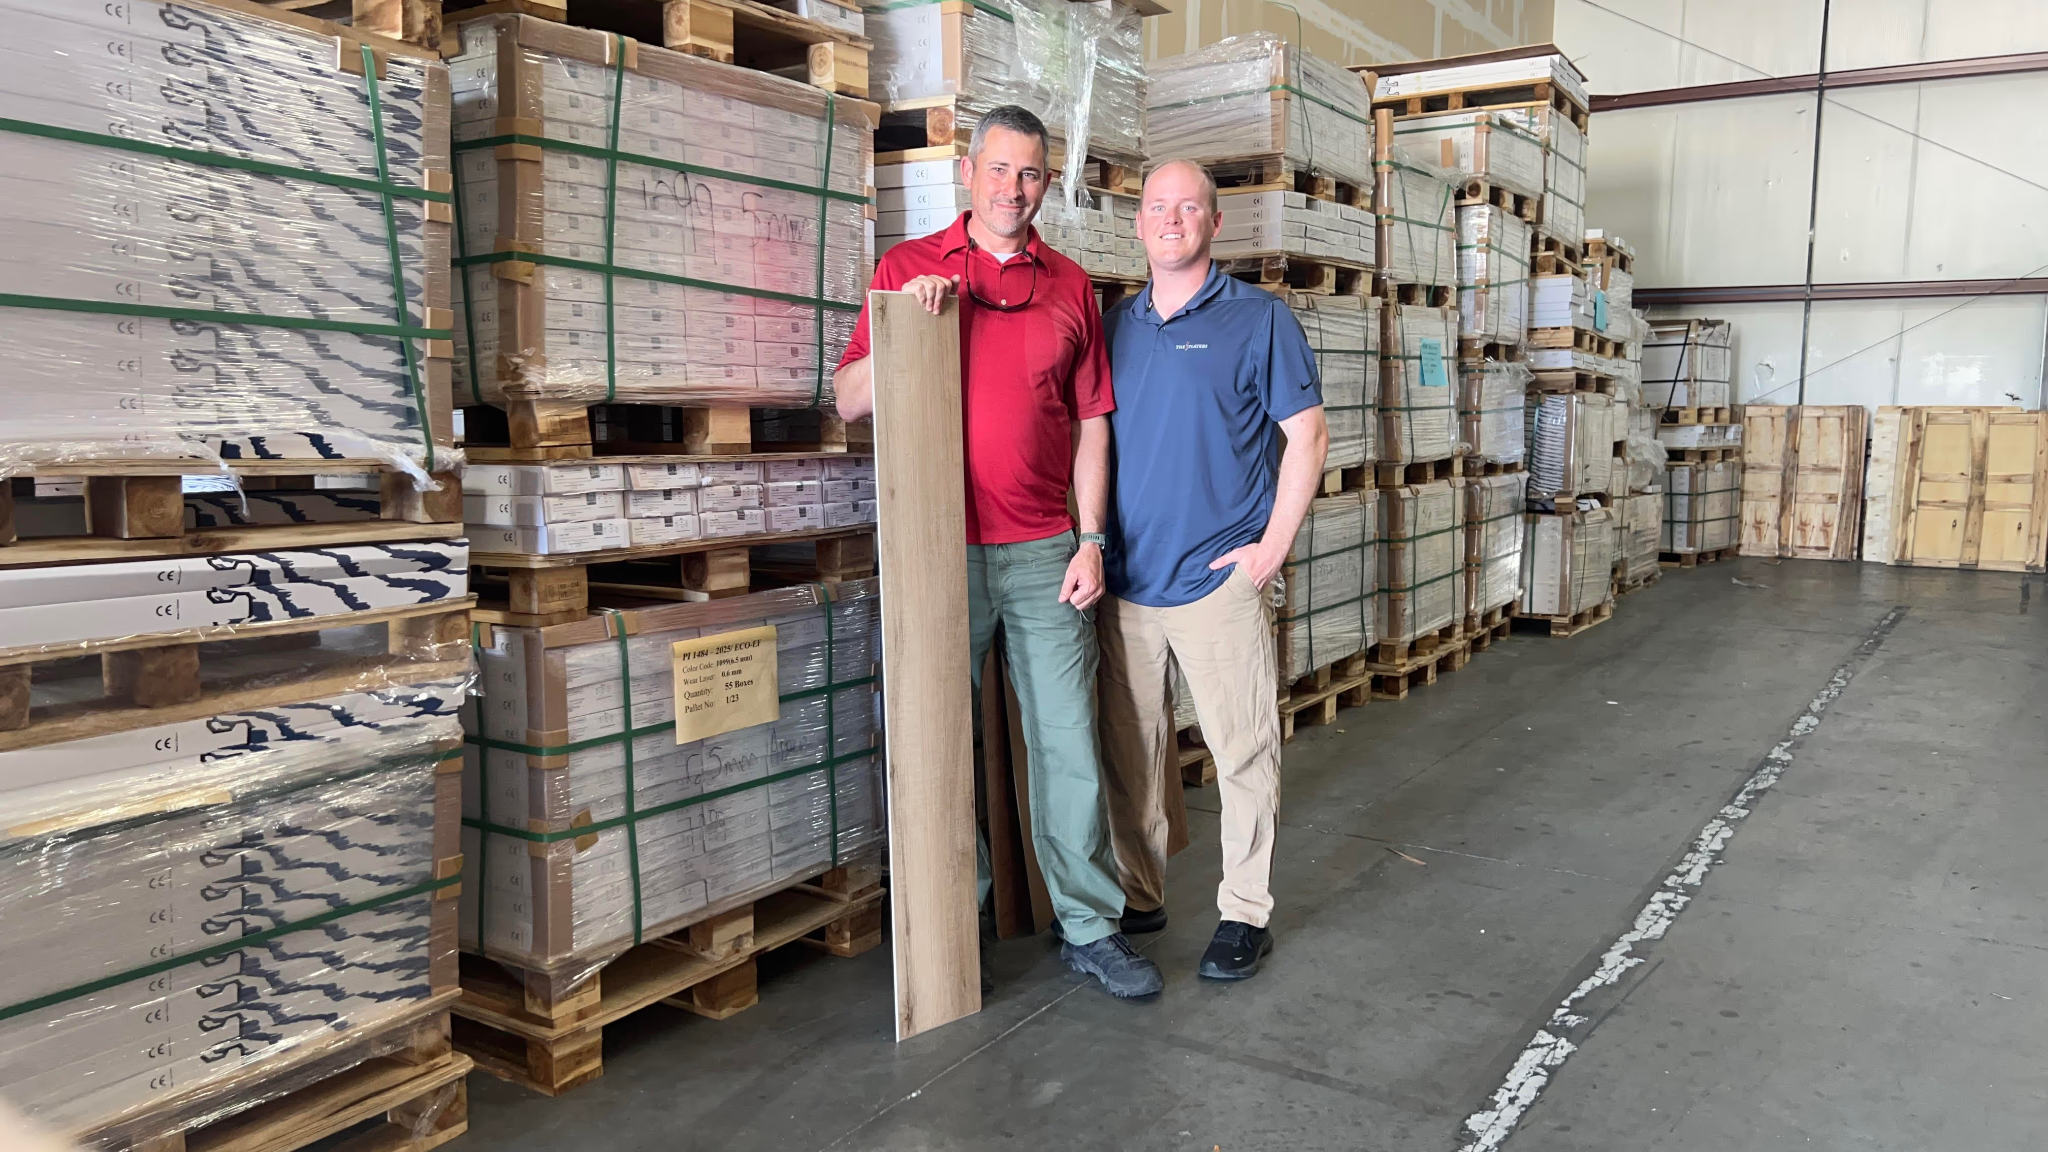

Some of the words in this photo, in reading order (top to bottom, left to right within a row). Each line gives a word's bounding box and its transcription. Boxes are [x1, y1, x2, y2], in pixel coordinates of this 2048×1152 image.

[105, 3, 122, 18] CE
[107, 41, 125, 57] CE
[476, 67, 486, 79] CE
[106, 81, 123, 96] CE
[916, 169, 925, 178] CE
[918, 195, 927, 203] CE
[918, 217, 927, 226] CE
[116, 282, 133, 297] CE
[117, 321, 134, 335] CE
[117, 359, 135, 372] CE
[120, 397, 137, 410] CE
[497, 474, 508, 485] CE
[499, 503, 509, 513] CE
[503, 532, 513, 542] CE
[157, 570, 175, 582] CE
[155, 604, 173, 617] CE
[682, 652, 691, 661] PI
[692, 649, 709, 659] 1484
[682, 665, 698, 674] Color
[683, 677, 698, 685] Wear
[683, 688, 713, 700] Quantity:
[724, 681, 733, 691] 55
[734, 679, 754, 689] Boxes
[684, 703, 703, 713] Pallet
[725, 693, 739, 704] 1/23
[155, 737, 171, 751] CE
[149, 909, 166, 924] CE
[150, 943, 167, 958] CE
[148, 977, 165, 992] CE
[145, 1009, 162, 1024] CE
[148, 1043, 165, 1058] CE
[150, 1074, 167, 1090] CE
